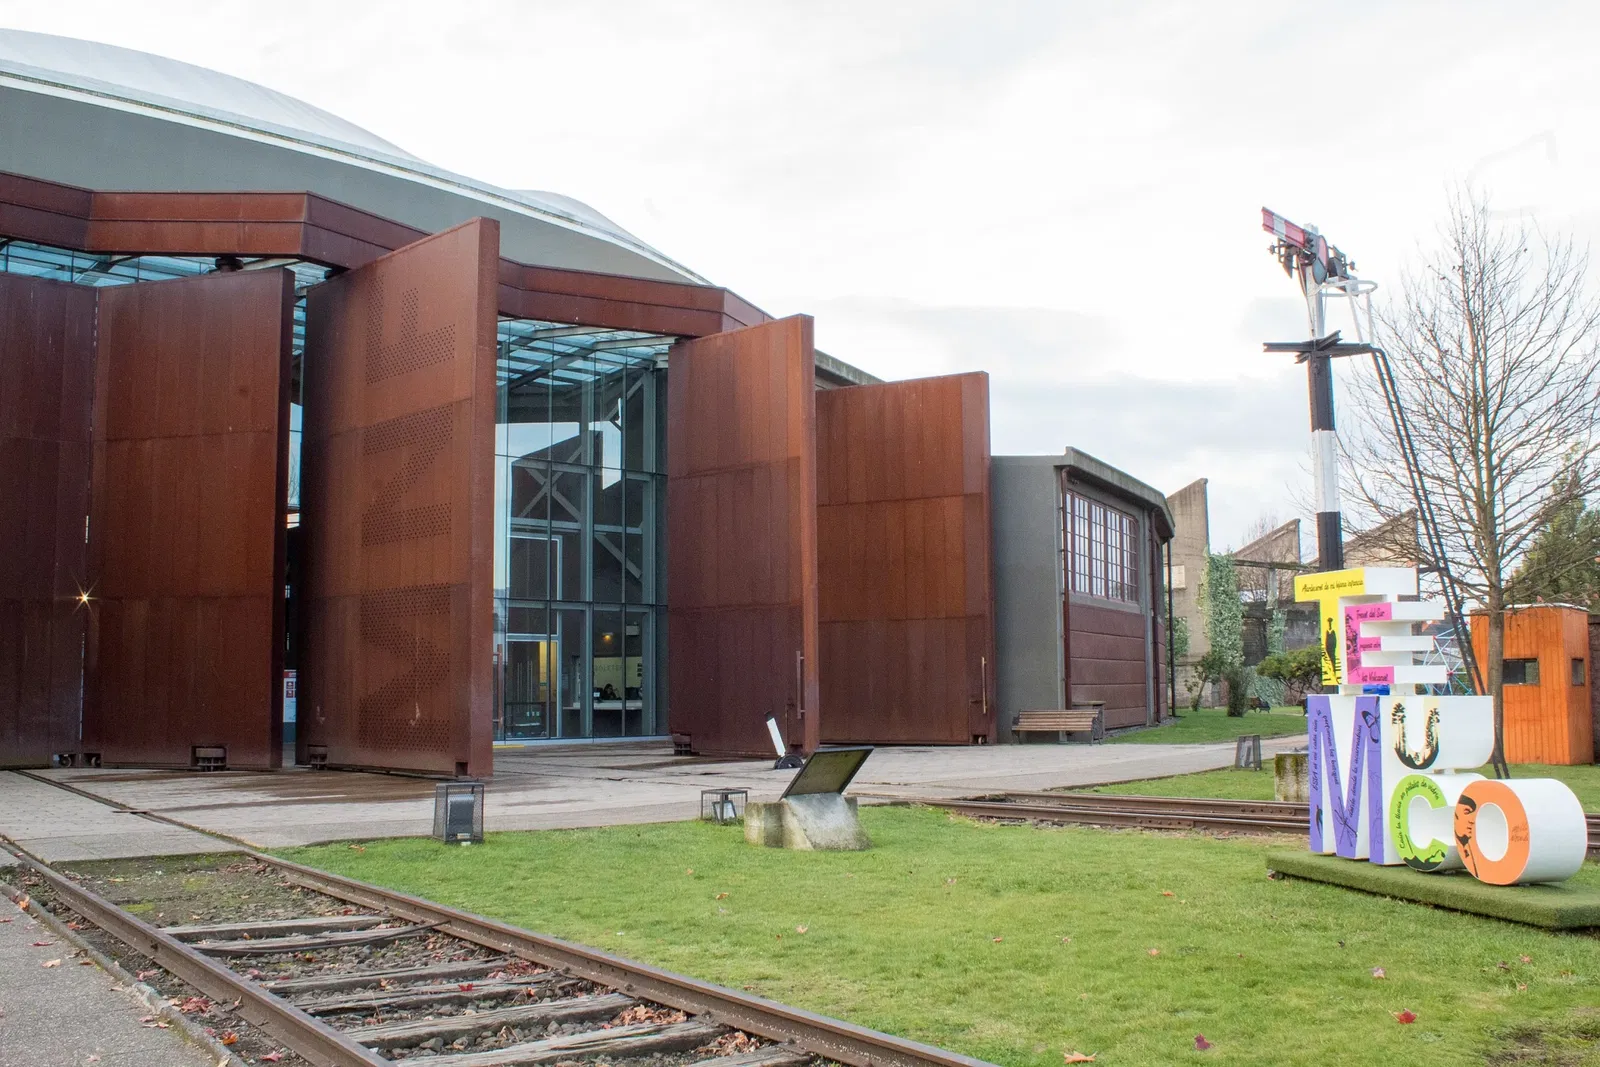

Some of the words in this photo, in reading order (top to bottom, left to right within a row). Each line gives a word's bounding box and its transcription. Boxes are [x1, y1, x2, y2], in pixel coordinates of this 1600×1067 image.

[1376, 607, 1385, 618] Sur
[1321, 715, 1333, 748] perfuman
[1396, 821, 1402, 830] la
